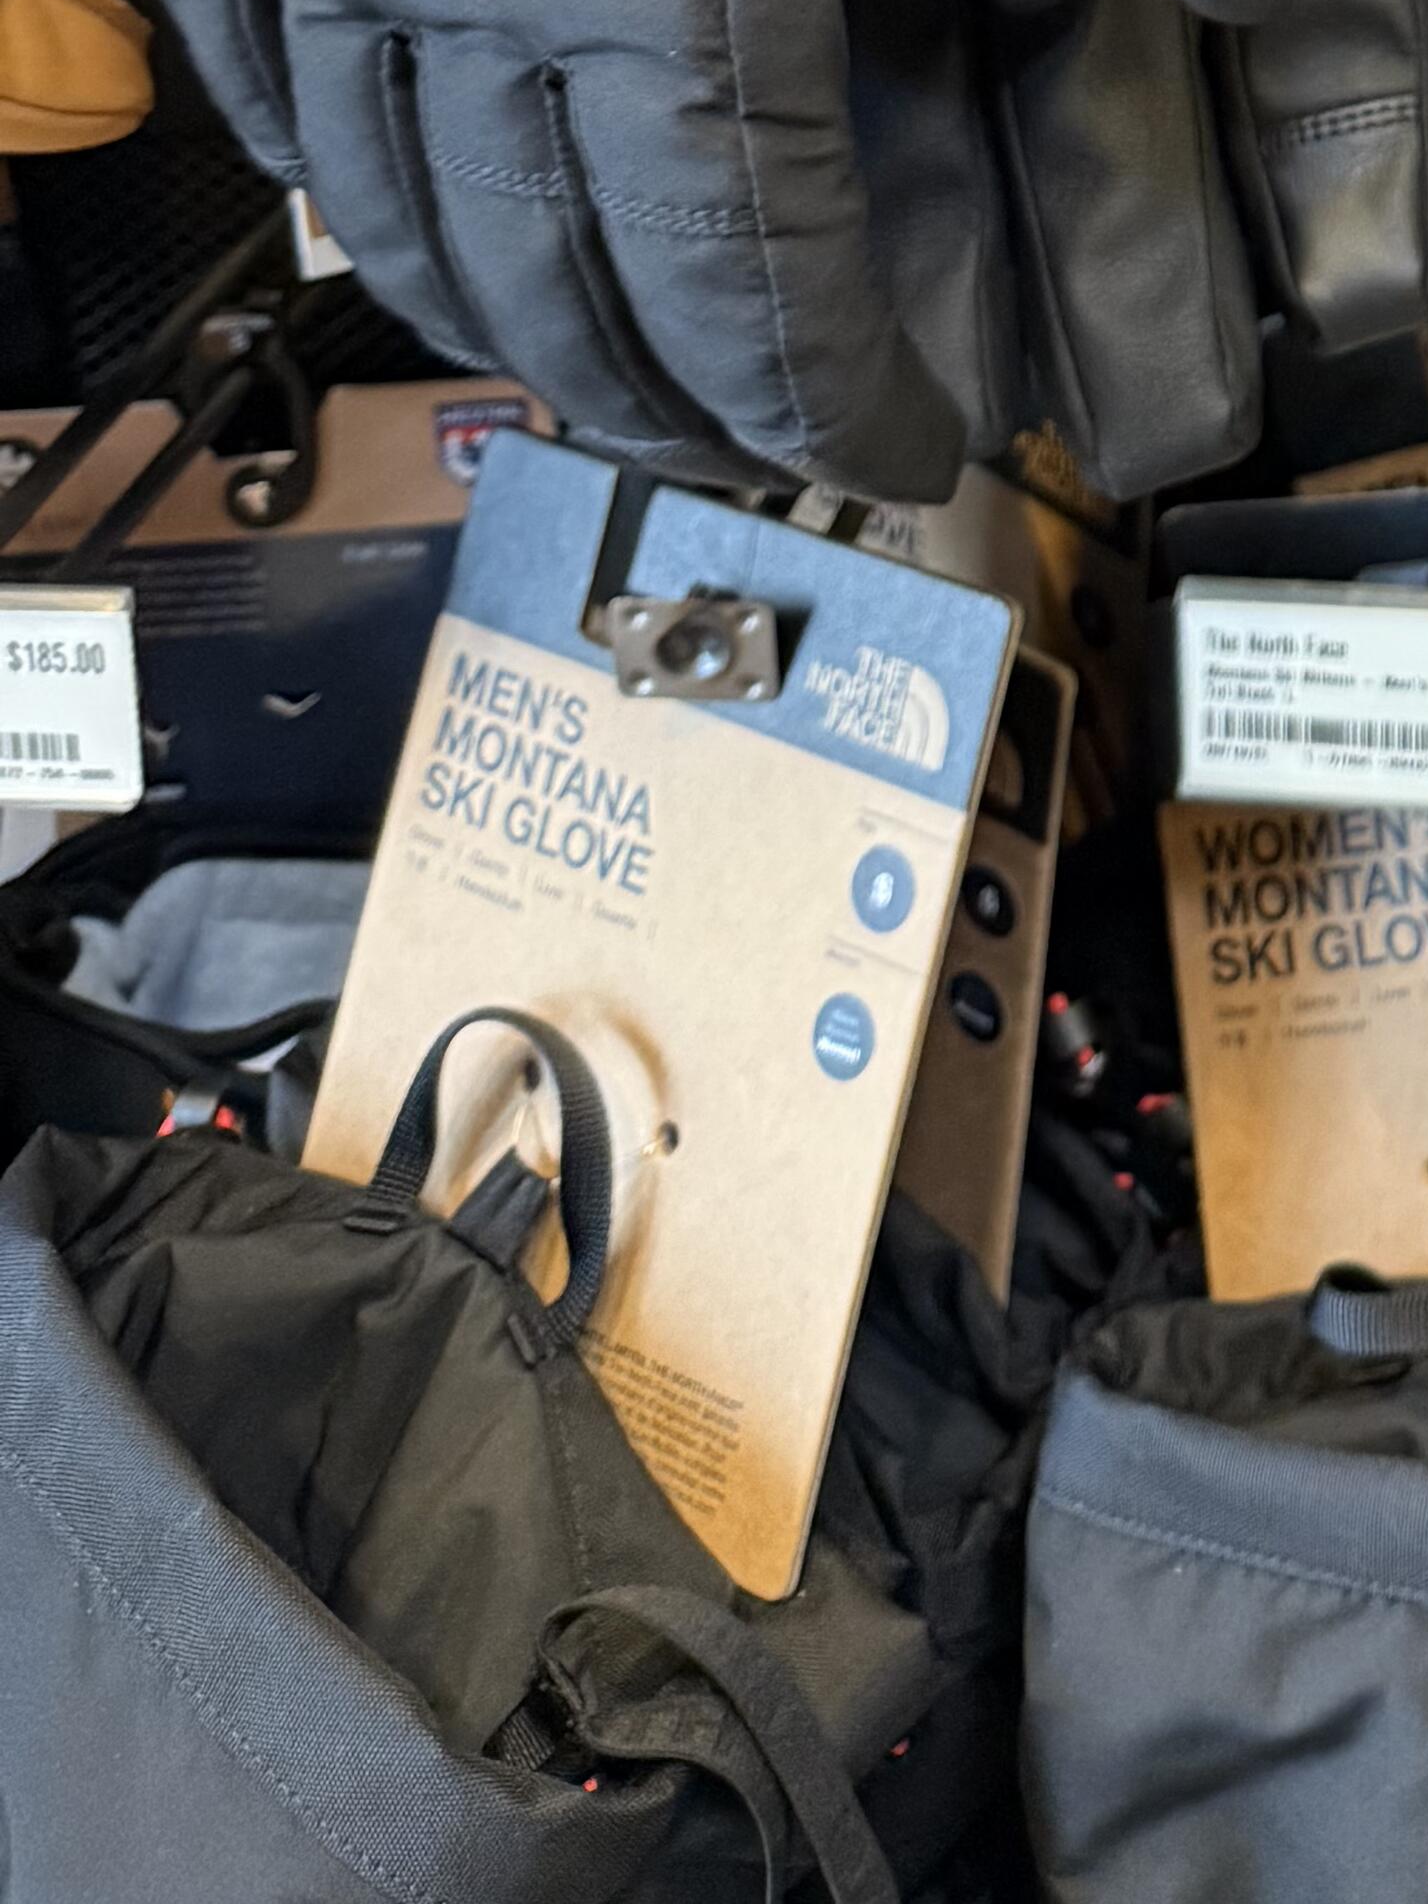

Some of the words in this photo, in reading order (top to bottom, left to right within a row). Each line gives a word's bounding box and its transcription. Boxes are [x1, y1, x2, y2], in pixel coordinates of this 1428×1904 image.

[6, 640, 107, 676] $185.00
[447, 651, 590, 747] MEN'S
[432, 705, 651, 837] MONTANA
[420, 760, 498, 830] SKI
[503, 795, 656, 897] GLOVE
[1208, 929, 1297, 986] SKI
